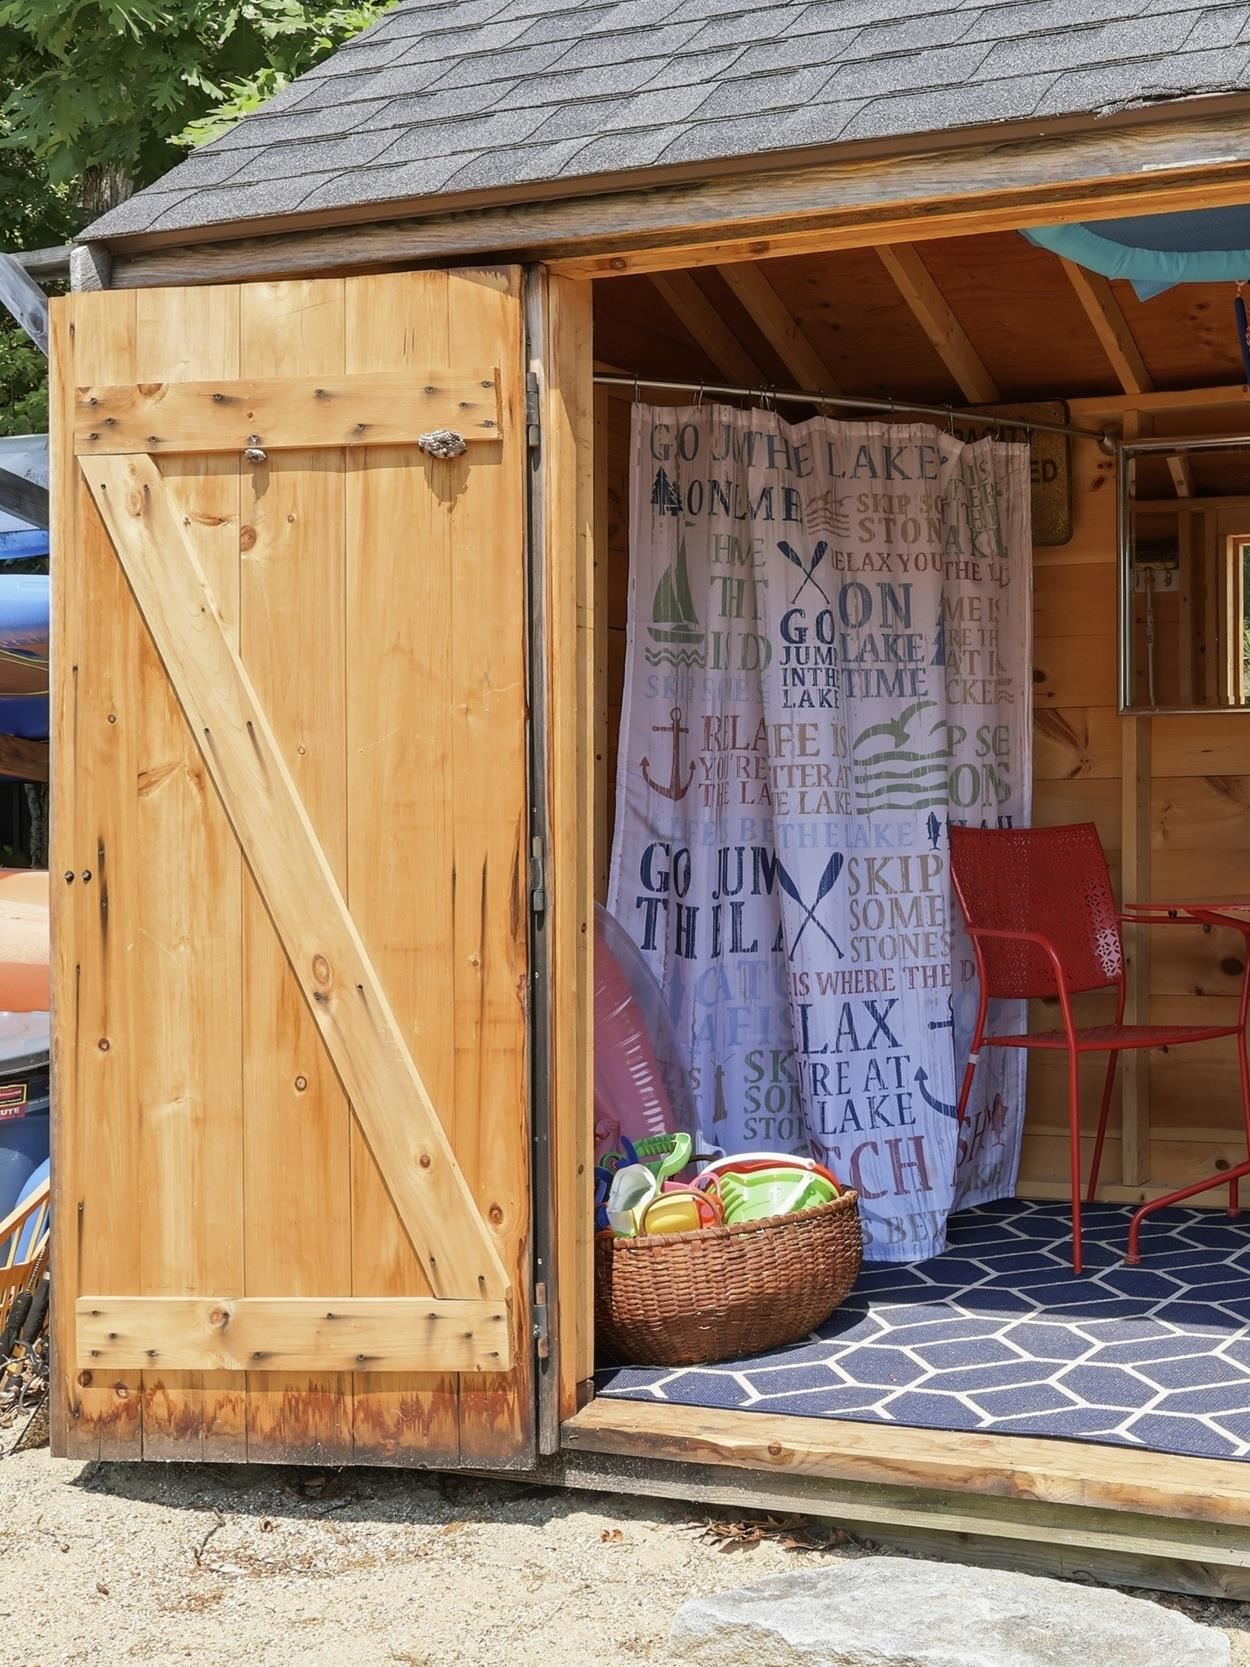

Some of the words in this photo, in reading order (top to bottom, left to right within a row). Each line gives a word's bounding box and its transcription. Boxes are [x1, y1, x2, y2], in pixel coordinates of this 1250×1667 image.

[650, 423, 700, 462] GO
[825, 441, 939, 481] LAKE
[831, 548, 893, 573] ELAX
[838, 581, 913, 630] ON
[779, 608, 835, 645] GO
[779, 646, 839, 666] JUM
[839, 632, 925, 663] LAKE
[840, 667, 929, 698] TIME
[797, 790, 853, 816] LAKE
[639, 841, 692, 898] GO
[847, 854, 944, 897] SKIP
[849, 894, 947, 932] SOME
[850, 931, 952, 964] STONES
[815, 967, 896, 996] WHERE
[902, 964, 951, 990] THE
[862, 1055, 911, 1093] AT
[818, 1091, 917, 1135] LAKE
